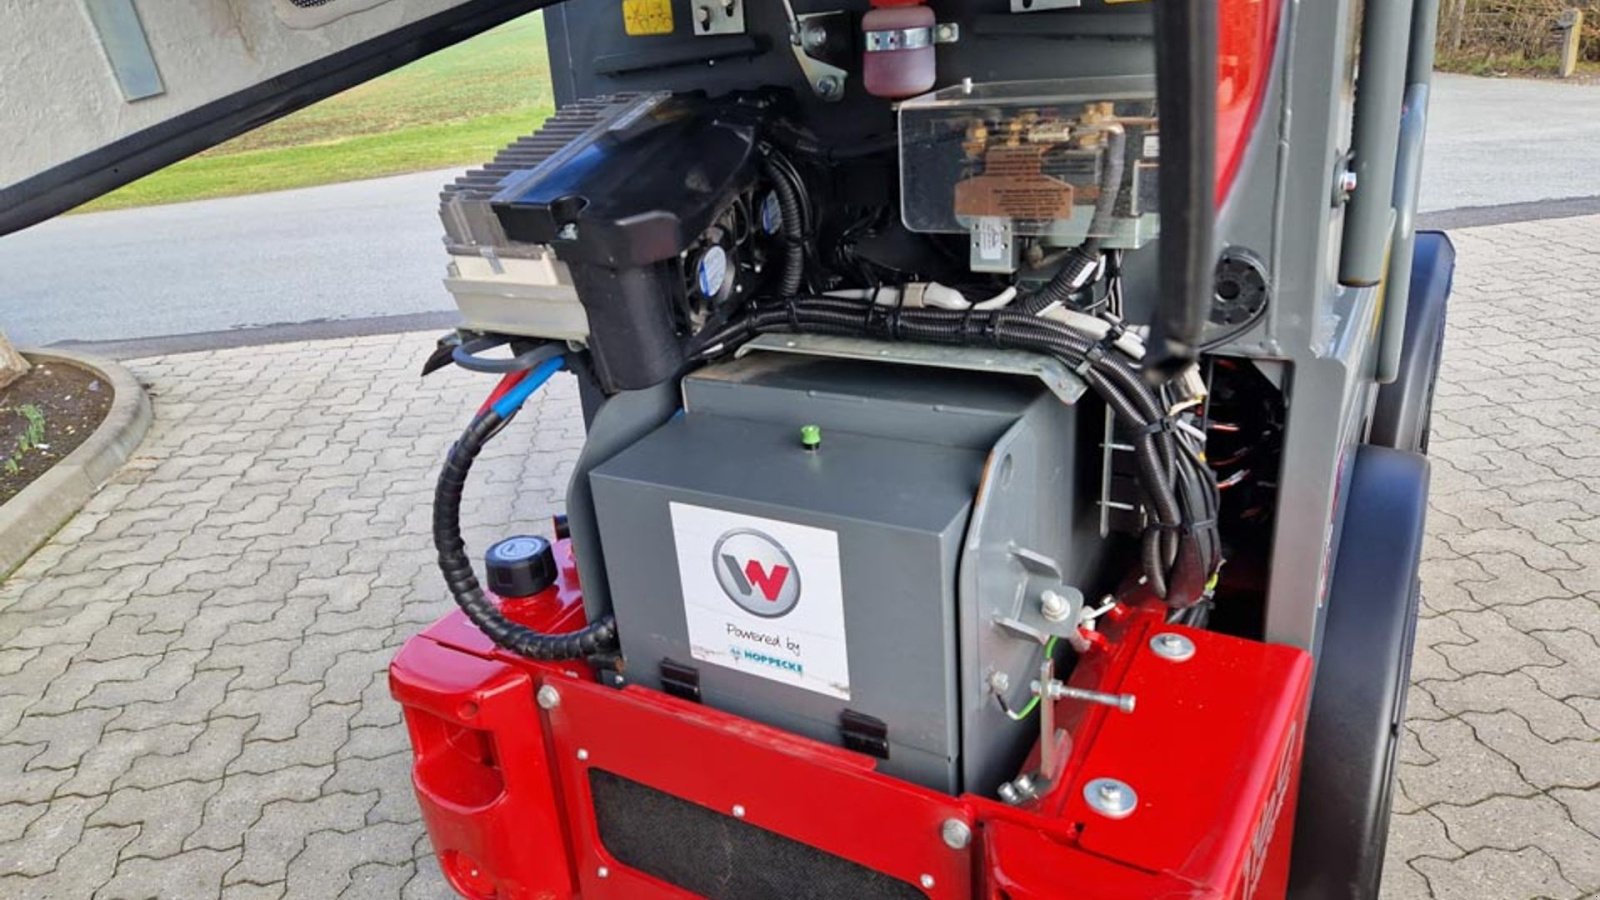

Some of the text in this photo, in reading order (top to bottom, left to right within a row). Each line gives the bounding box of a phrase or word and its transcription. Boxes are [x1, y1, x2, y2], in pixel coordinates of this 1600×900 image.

[726, 622, 801, 657] Powered by
[744, 651, 803, 674] HOPPECKE
